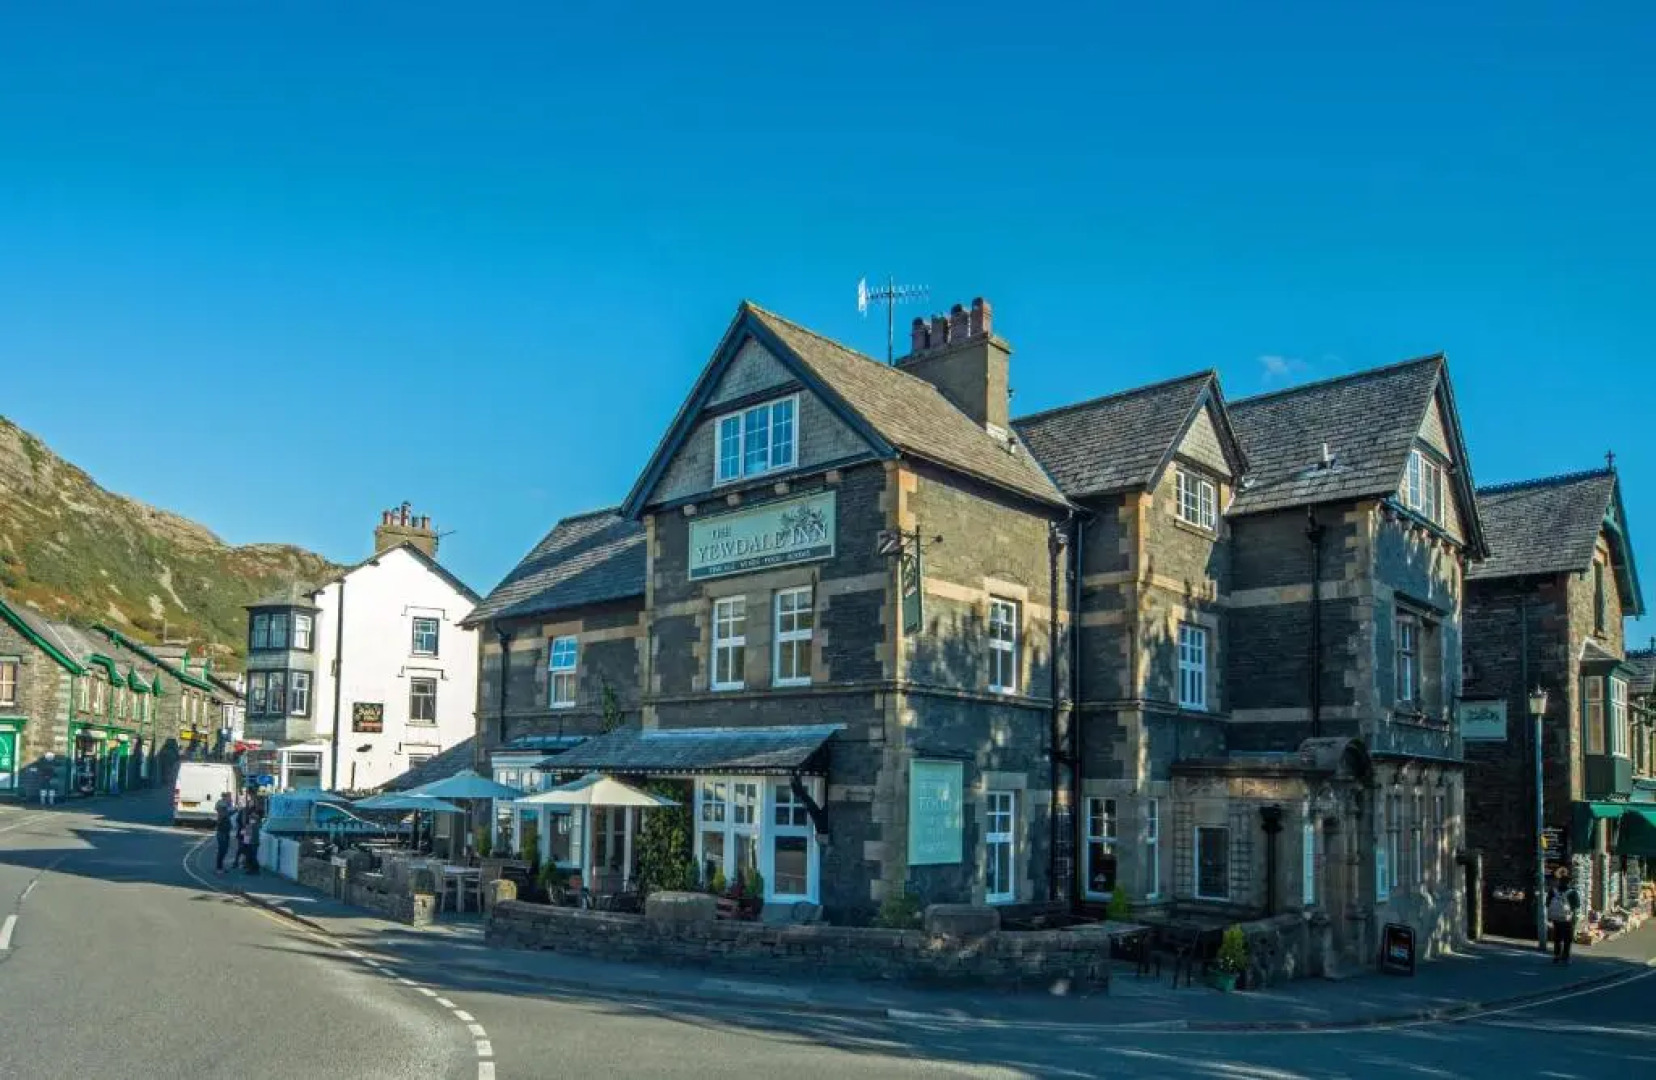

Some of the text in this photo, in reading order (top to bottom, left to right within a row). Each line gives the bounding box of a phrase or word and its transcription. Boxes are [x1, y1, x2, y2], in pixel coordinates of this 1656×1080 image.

[698, 523, 829, 562] YEWDALE INN
[711, 525, 732, 539] THE
